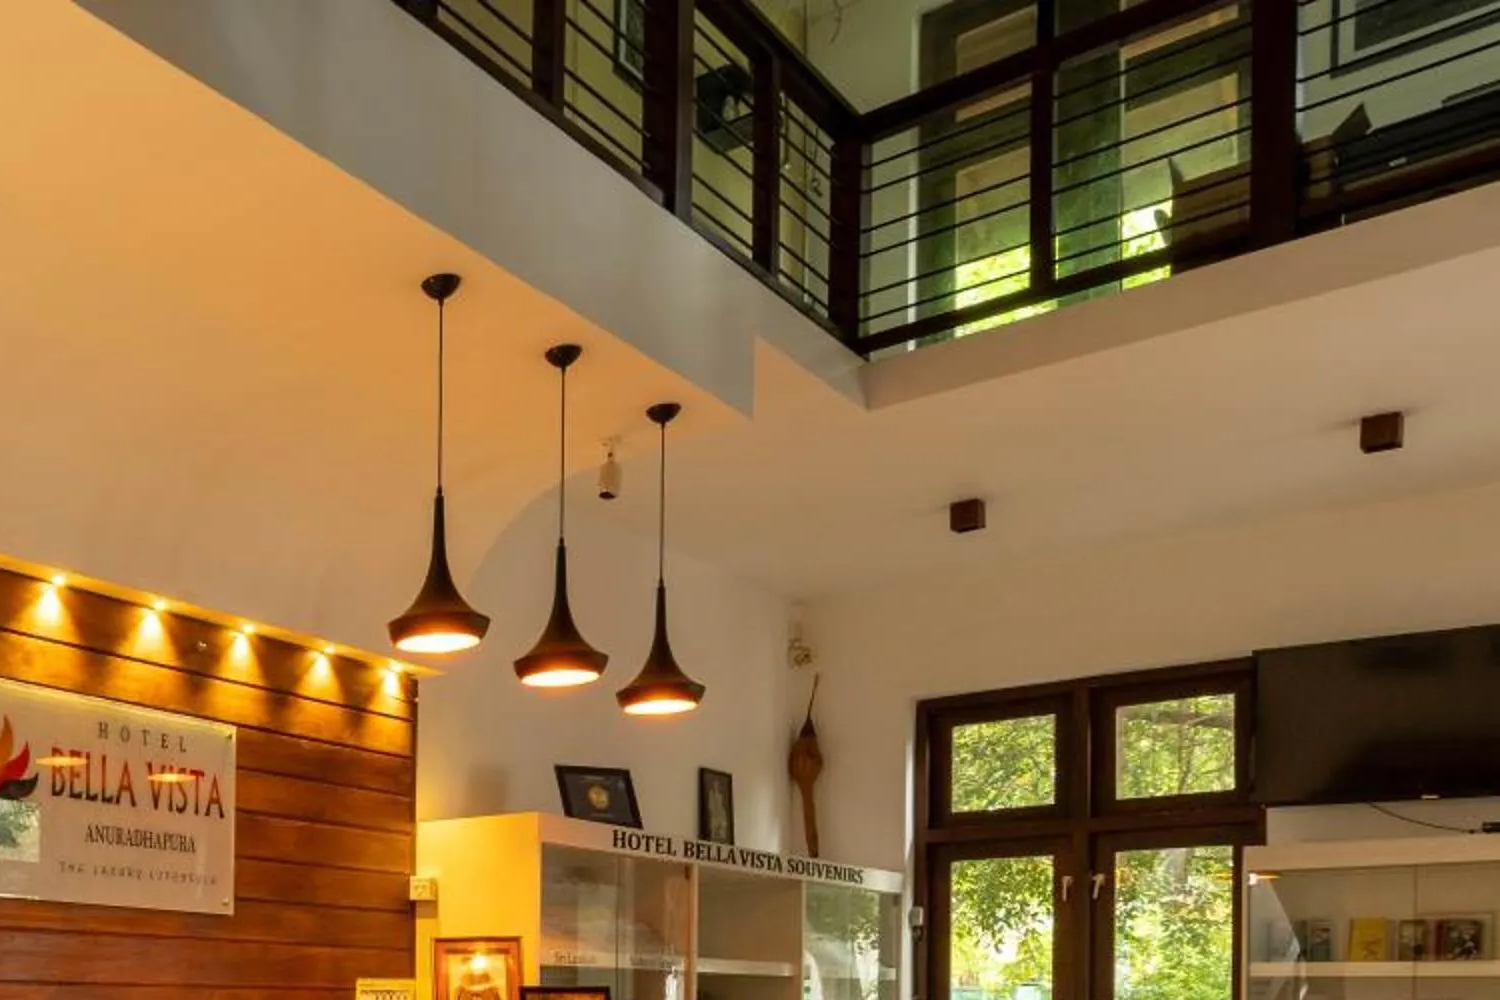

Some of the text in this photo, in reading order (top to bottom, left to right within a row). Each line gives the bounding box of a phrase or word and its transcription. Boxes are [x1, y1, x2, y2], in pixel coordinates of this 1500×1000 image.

[98, 721, 187, 753] HOTEL
[51, 747, 225, 819] BELLA VISTA
[85, 824, 197, 853] ANURADHAPURA
[612, 829, 865, 885] HOTEL BELLA VISTA SOUVENIRS
